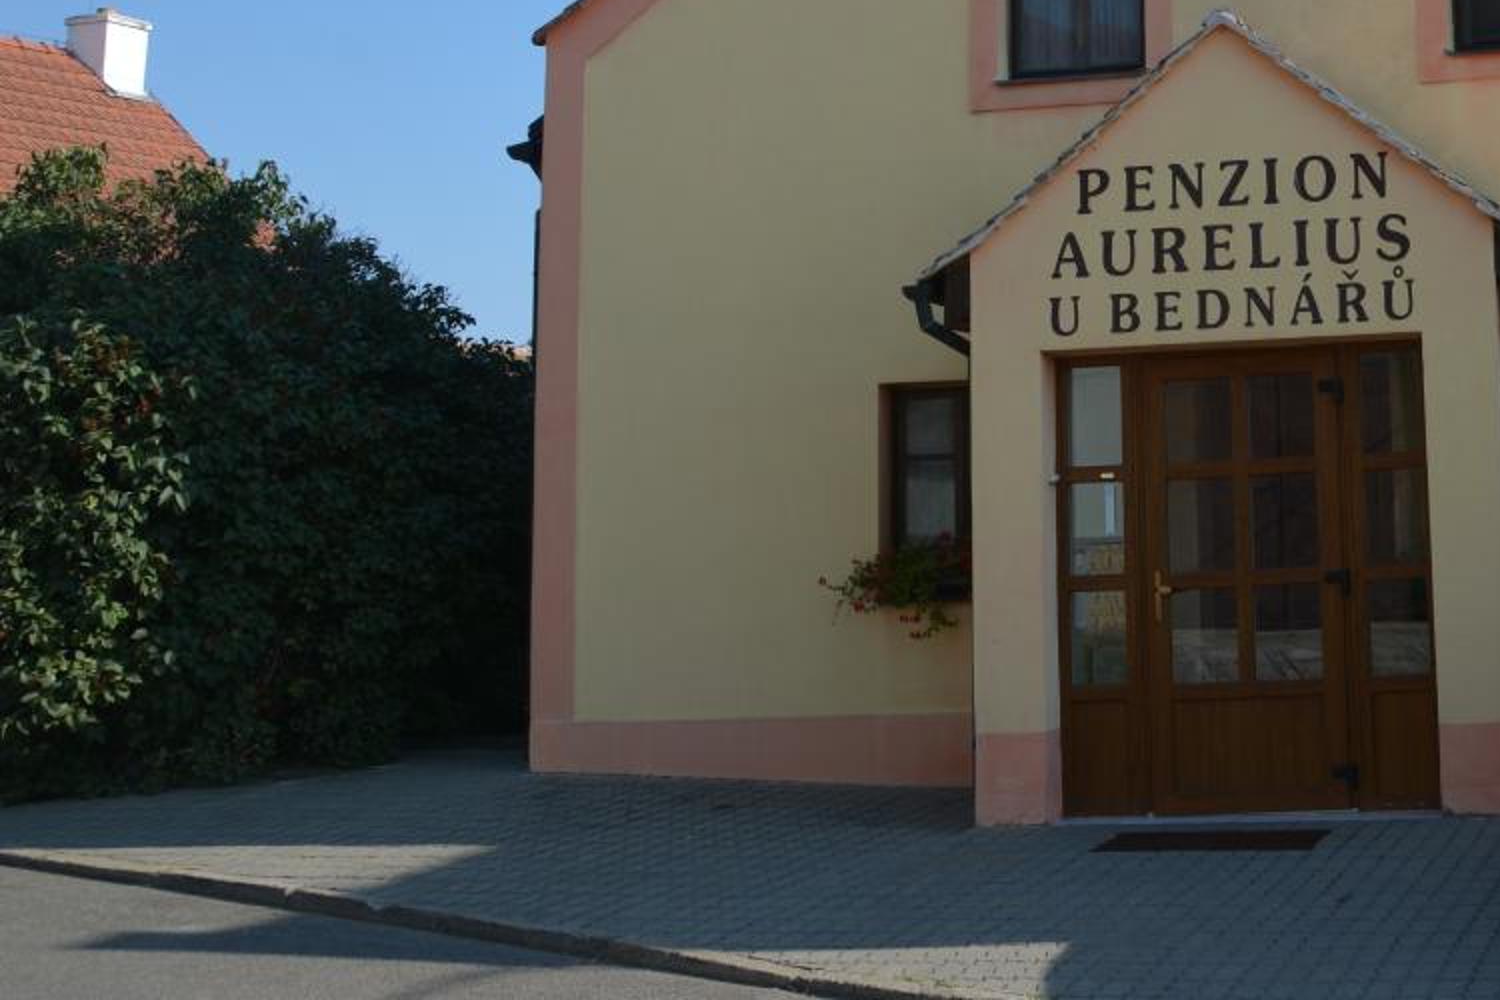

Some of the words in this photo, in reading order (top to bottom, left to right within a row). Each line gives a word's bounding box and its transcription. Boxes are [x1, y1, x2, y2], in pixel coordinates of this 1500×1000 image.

[1076, 151, 1389, 215] PENZION
[1052, 213, 1411, 281] AURELIUS
[1050, 296, 1081, 337] U
[1110, 267, 1415, 334] BEDNÁŘŮ
